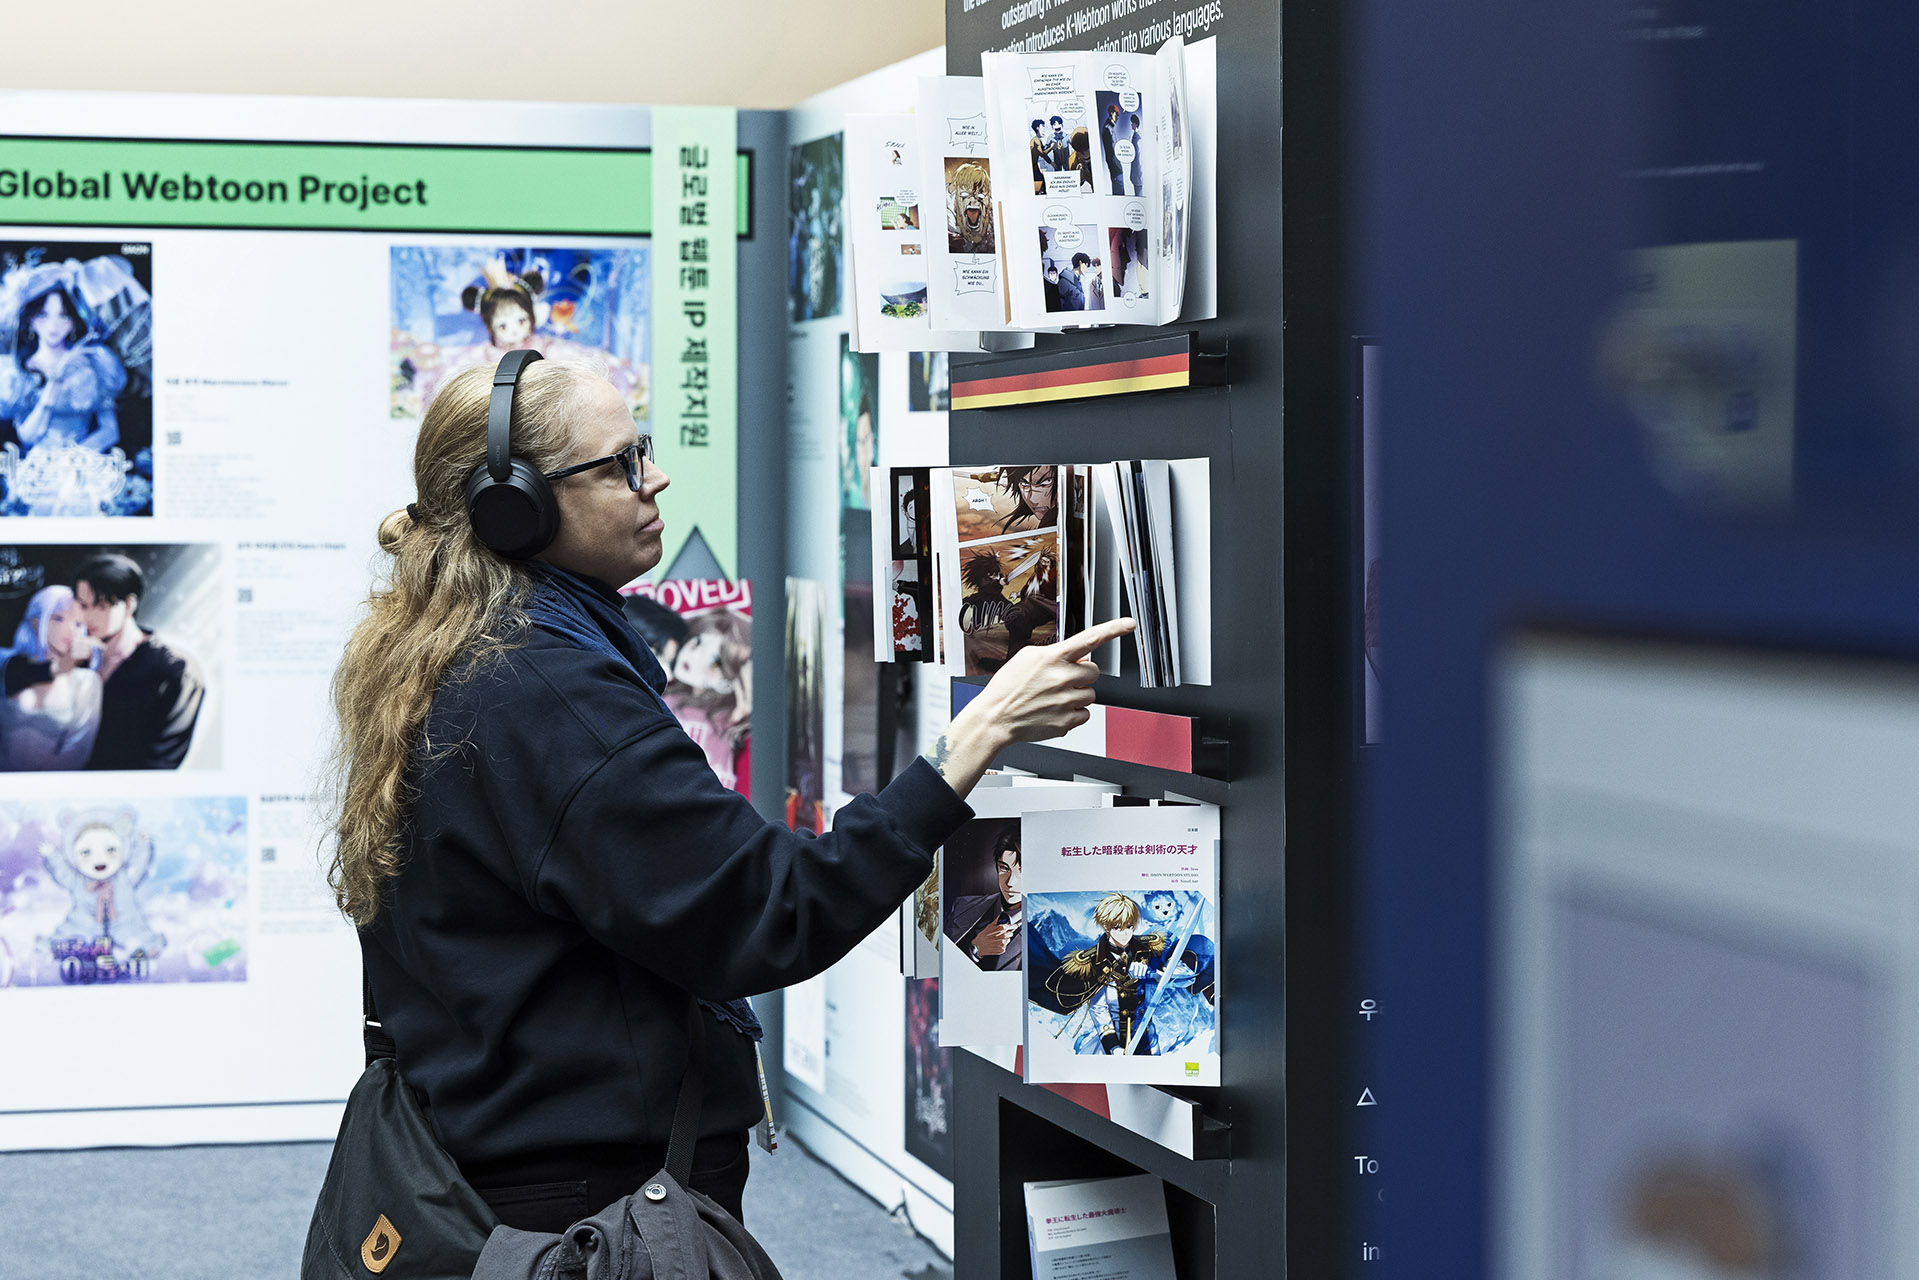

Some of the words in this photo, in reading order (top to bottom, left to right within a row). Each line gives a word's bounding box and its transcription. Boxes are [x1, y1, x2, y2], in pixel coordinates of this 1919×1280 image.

[1001, 0, 1045, 29] outstanding
[1026, 23, 1065, 52] introduces
[1066, 4, 1110, 39] K-Webtoon
[1111, 0, 1137, 20] works
[1121, 30, 1138, 53] into
[1139, 18, 1171, 49] various
[1172, 0, 1224, 37] languages.
[0, 169, 111, 200] Global
[122, 171, 288, 203] Webtoon
[299, 175, 428, 211] Project
[679, 146, 708, 225] 글로벌
[679, 238, 708, 289] 웹툰
[683, 300, 706, 327] IP
[679, 335, 709, 446] 제작지원
[1060, 844, 1199, 857] 転生した暗殺者は剣術の天才
